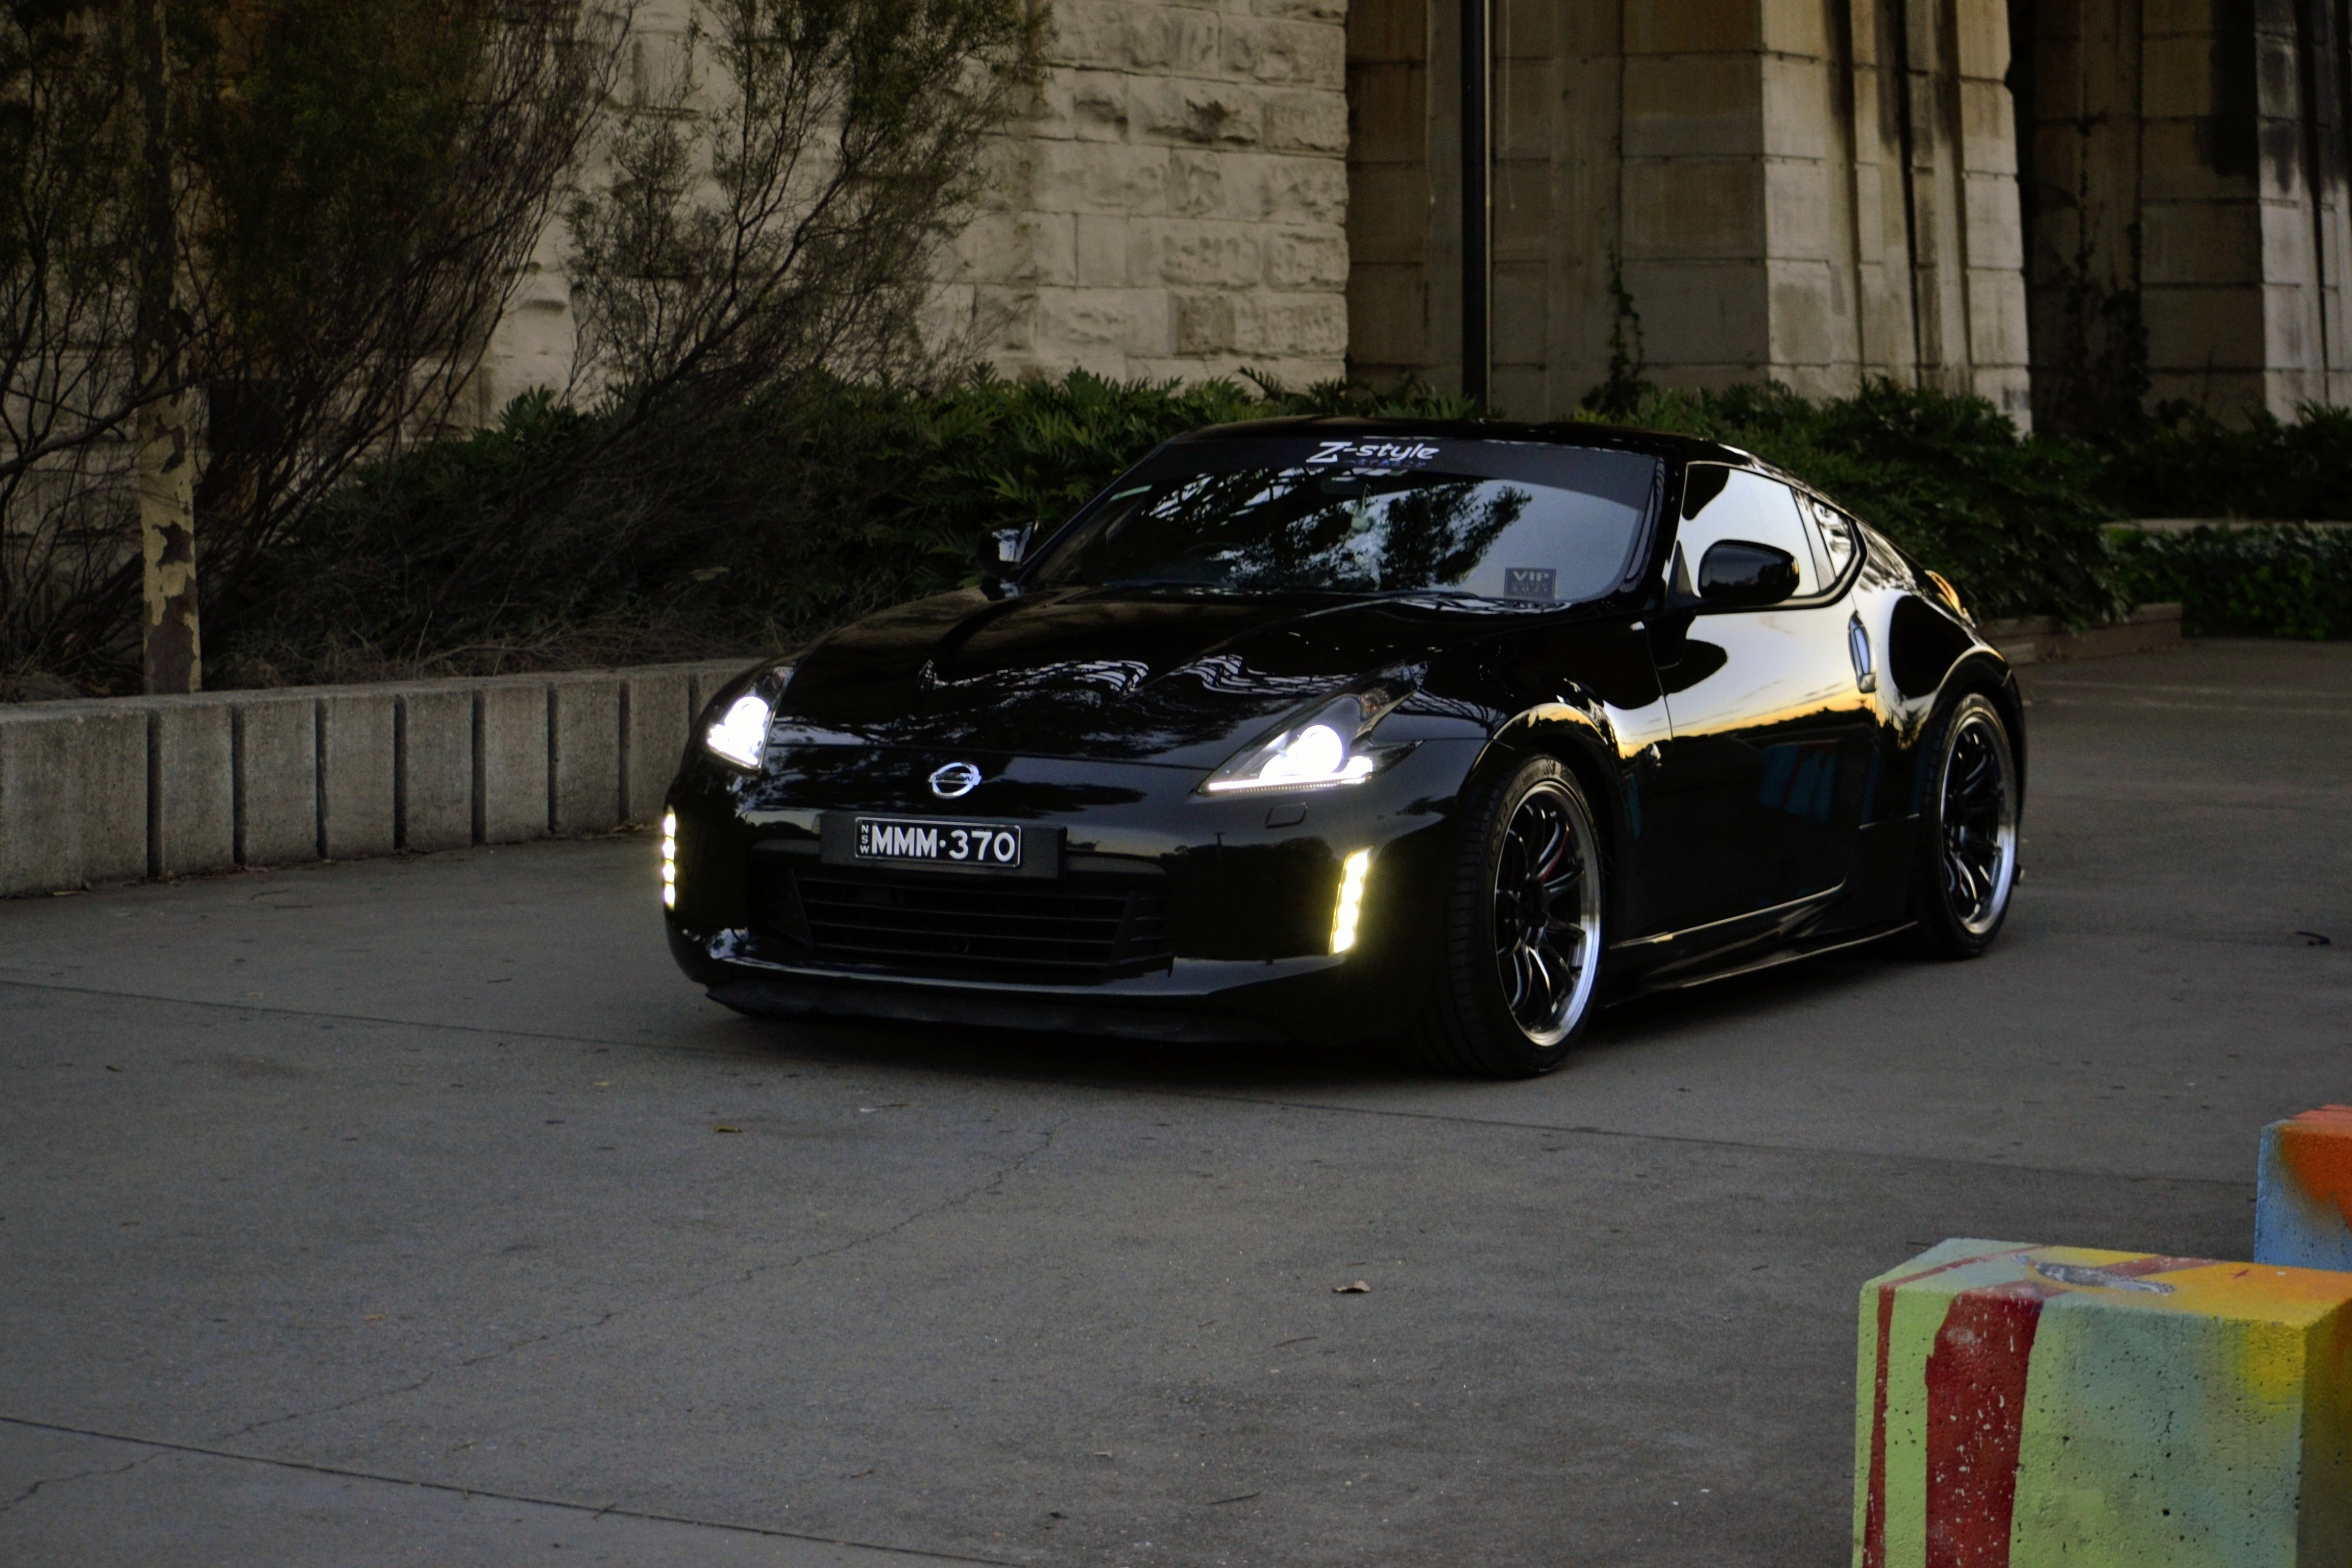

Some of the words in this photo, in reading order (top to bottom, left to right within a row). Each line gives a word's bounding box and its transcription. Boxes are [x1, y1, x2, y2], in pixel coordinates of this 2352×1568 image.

[1306, 441, 1439, 463] Z-style
[1512, 571, 1550, 581] VIP
[860, 824, 869, 854] NSW
